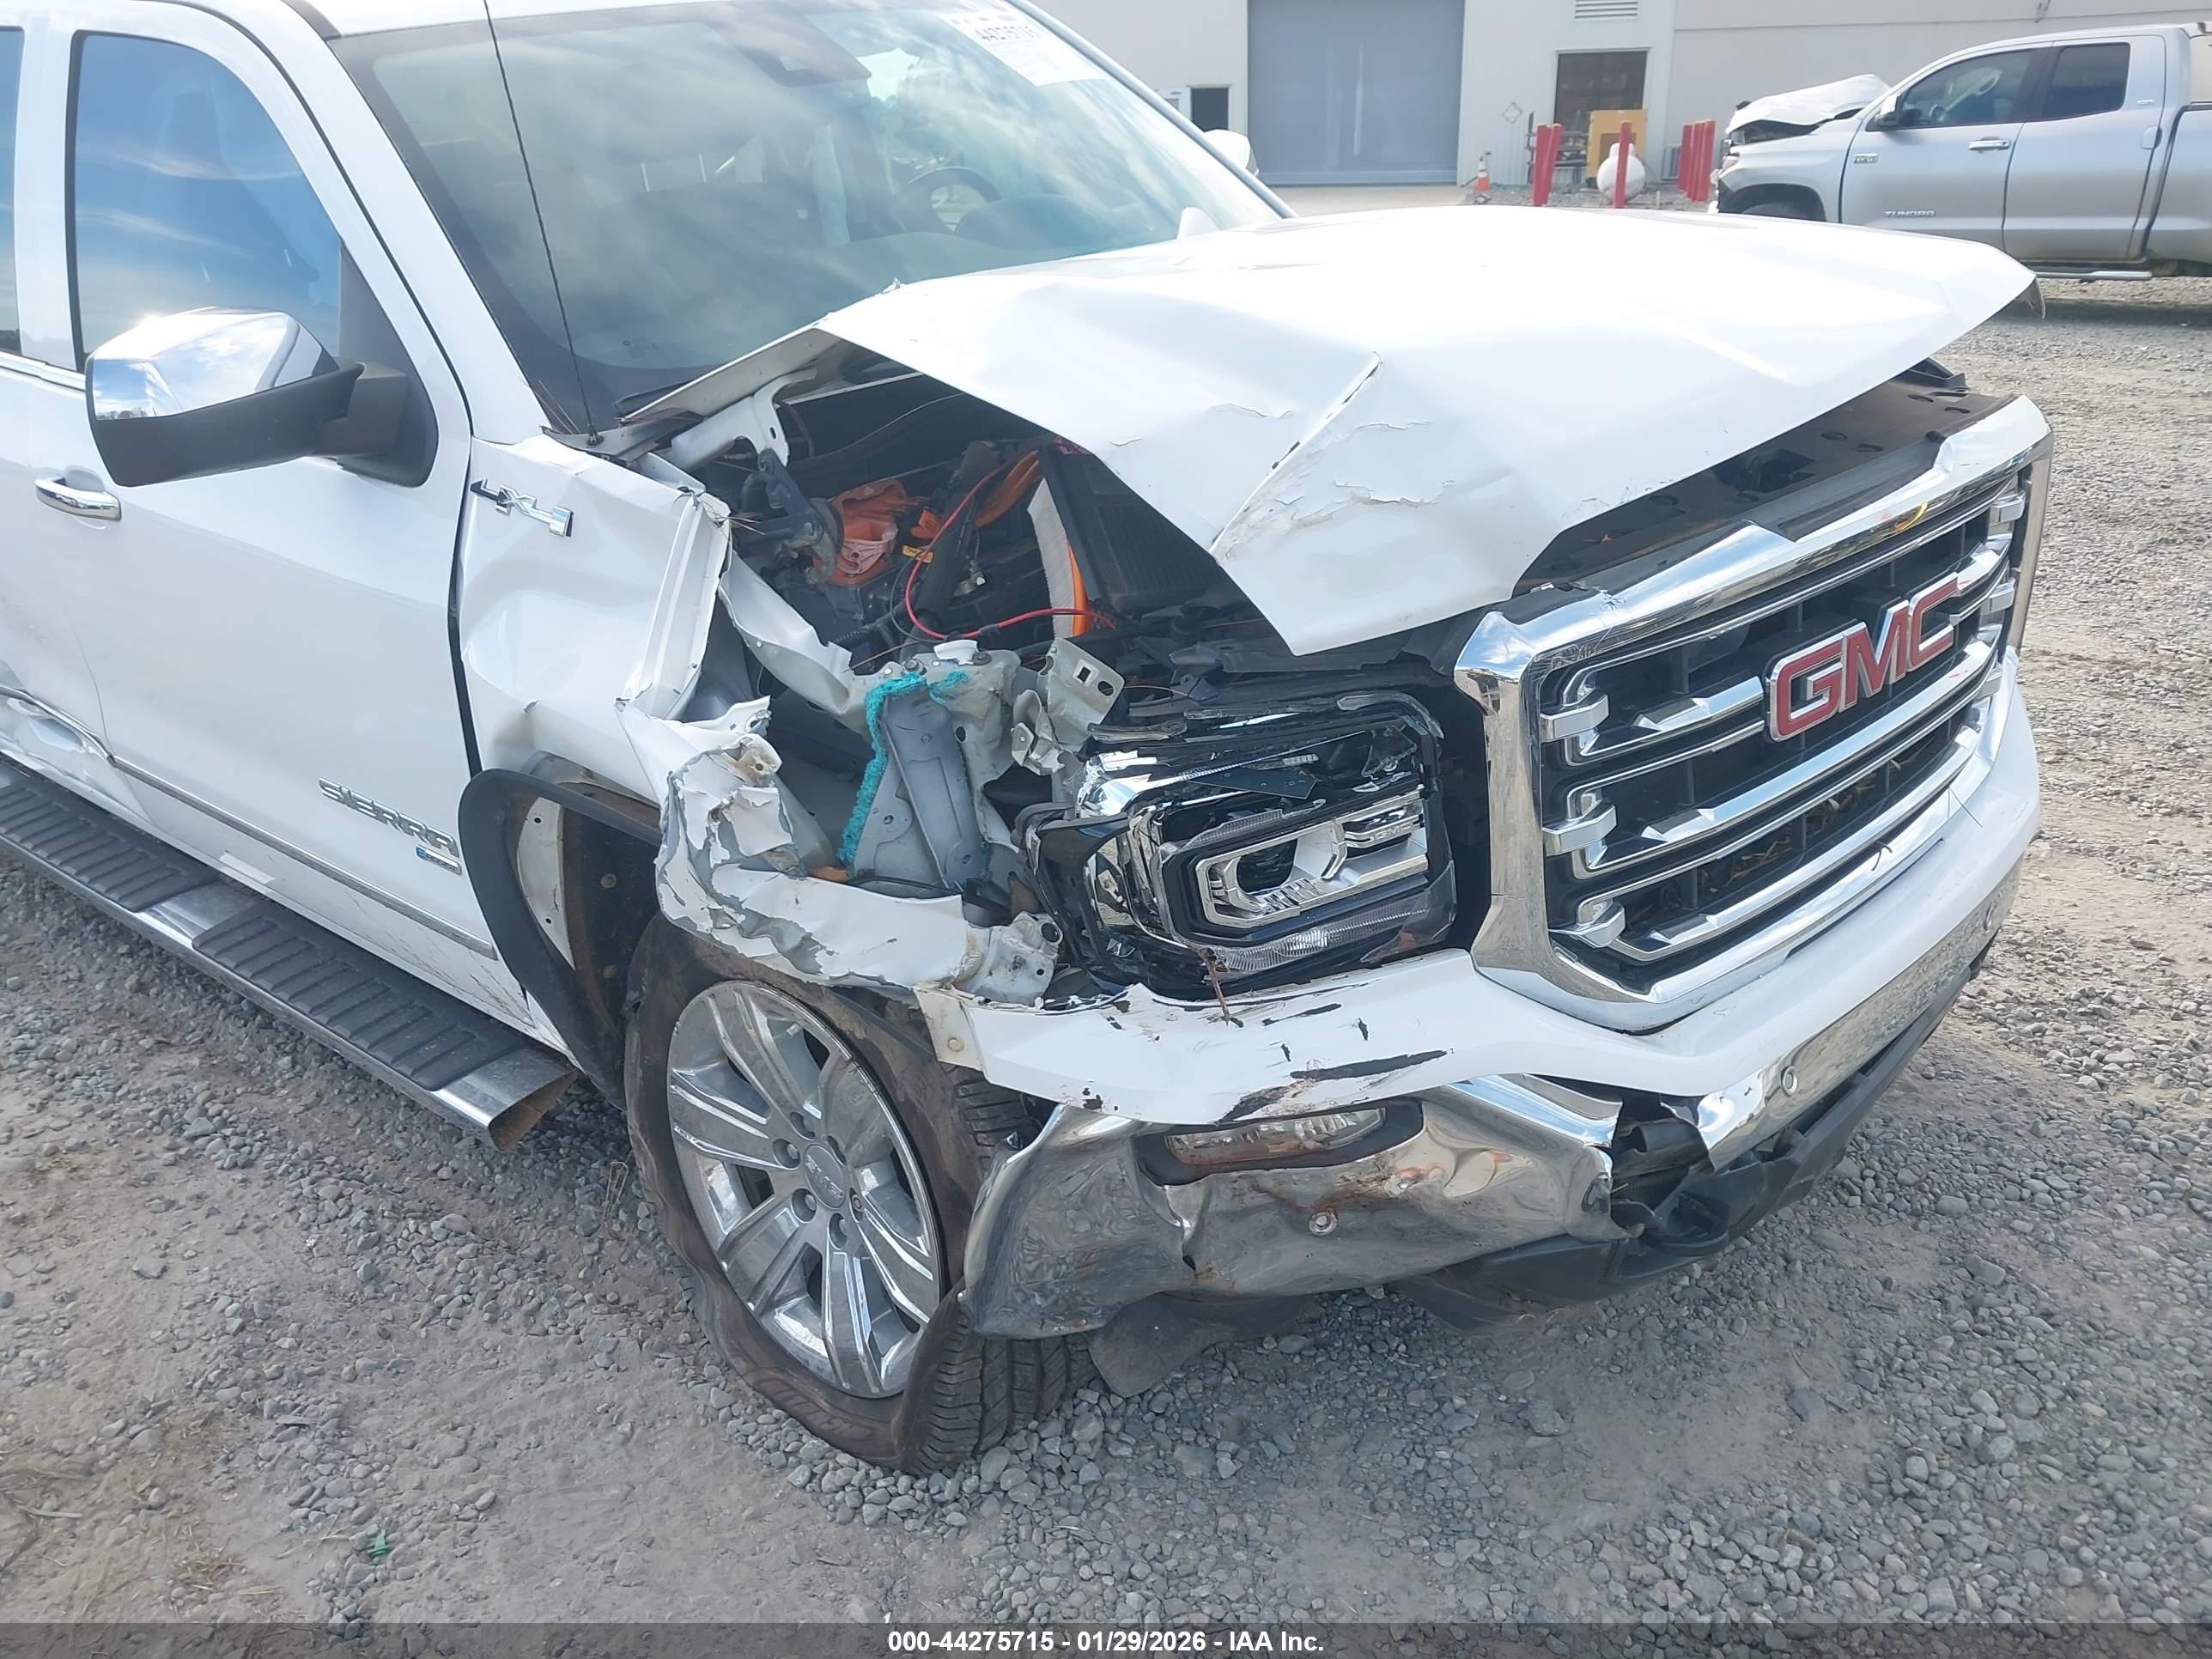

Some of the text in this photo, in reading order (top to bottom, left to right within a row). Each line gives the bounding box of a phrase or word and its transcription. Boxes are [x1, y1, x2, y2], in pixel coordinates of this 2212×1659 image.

[1884, 210, 1936, 219] TUNDRA
[1770, 571, 1959, 743] GMC
[319, 777, 460, 858] SIERRA
[1375, 822, 1413, 840] GMC
[805, 1154, 844, 1200] GMC
